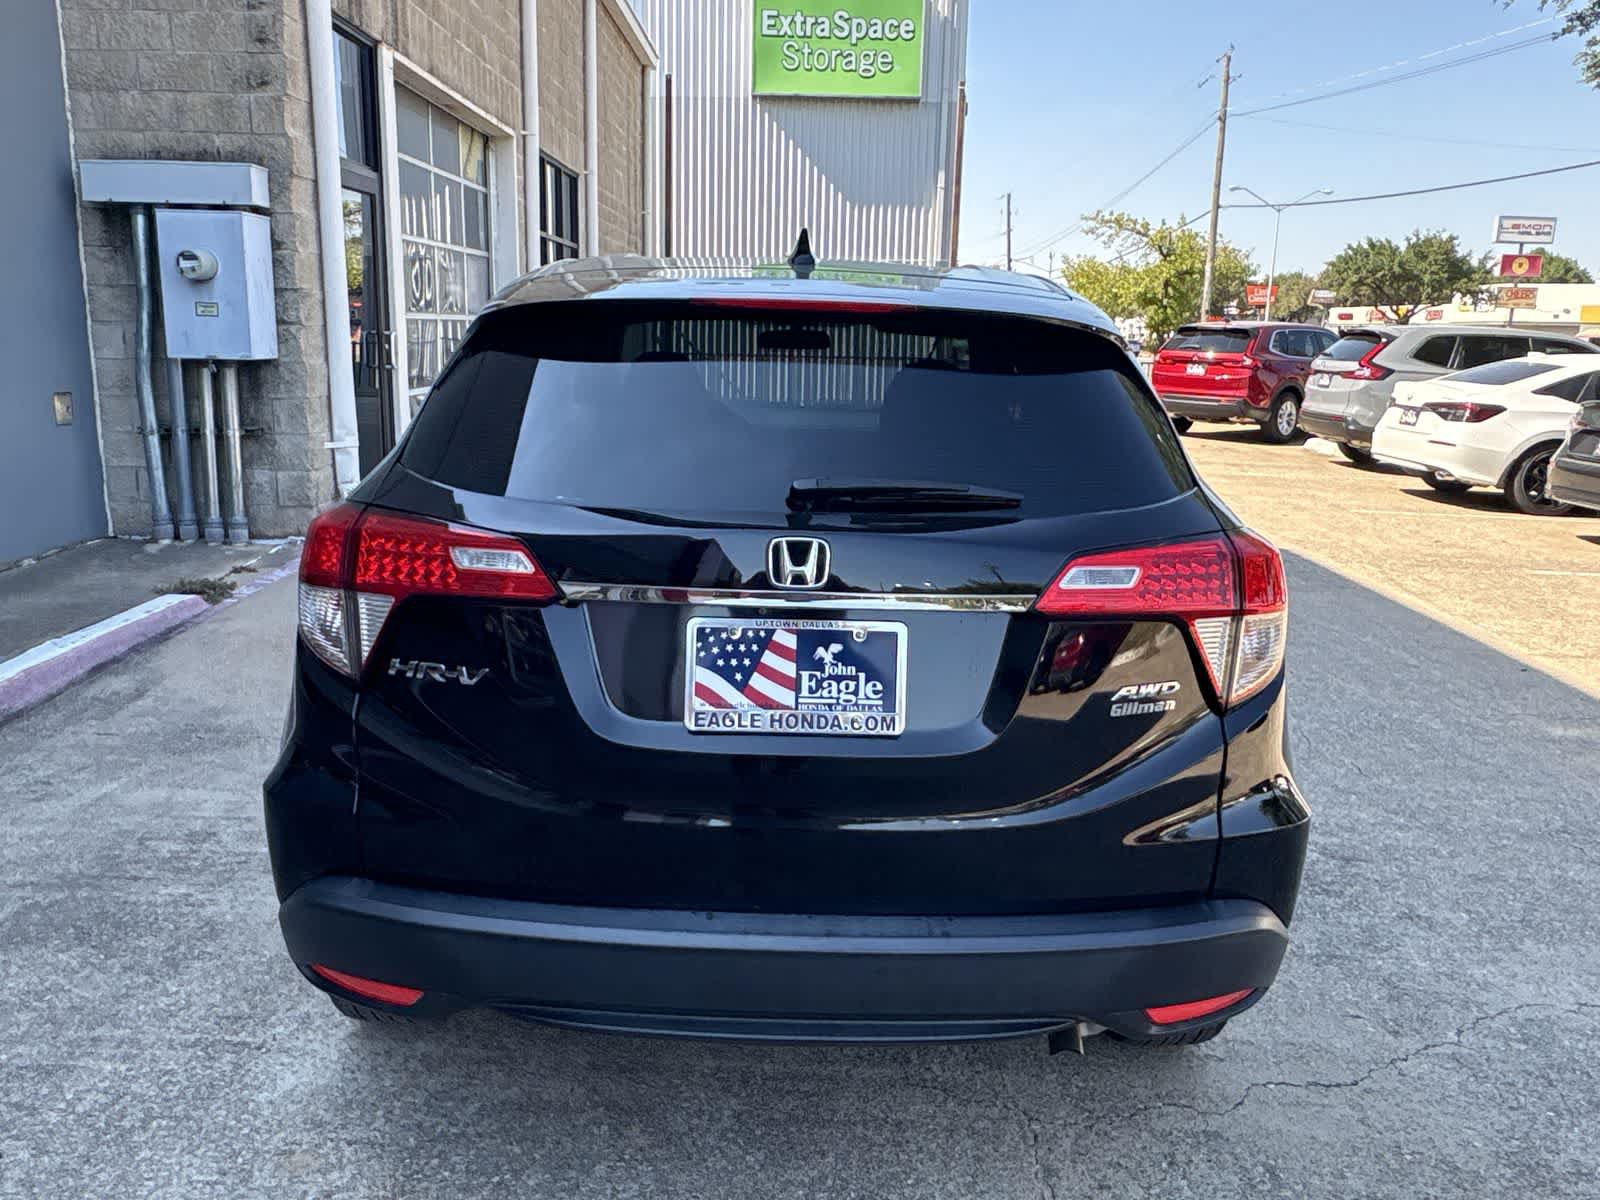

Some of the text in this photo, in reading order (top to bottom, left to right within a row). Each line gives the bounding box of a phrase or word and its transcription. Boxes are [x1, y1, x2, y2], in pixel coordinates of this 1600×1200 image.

[761, 9, 915, 45] ExtraSpace
[782, 40, 893, 78] Storage
[755, 619, 800, 629] UPTOWN
[387, 658, 490, 686] HR-V
[822, 662, 857, 678] John
[798, 670, 884, 705] Eagle
[1111, 681, 1181, 701] AWD
[798, 703, 829, 712] HONDA
[846, 704, 884, 712] DALLAS
[1110, 700, 1177, 718] Gillman
[694, 711, 897, 732] EAGLE HONDA.COM
